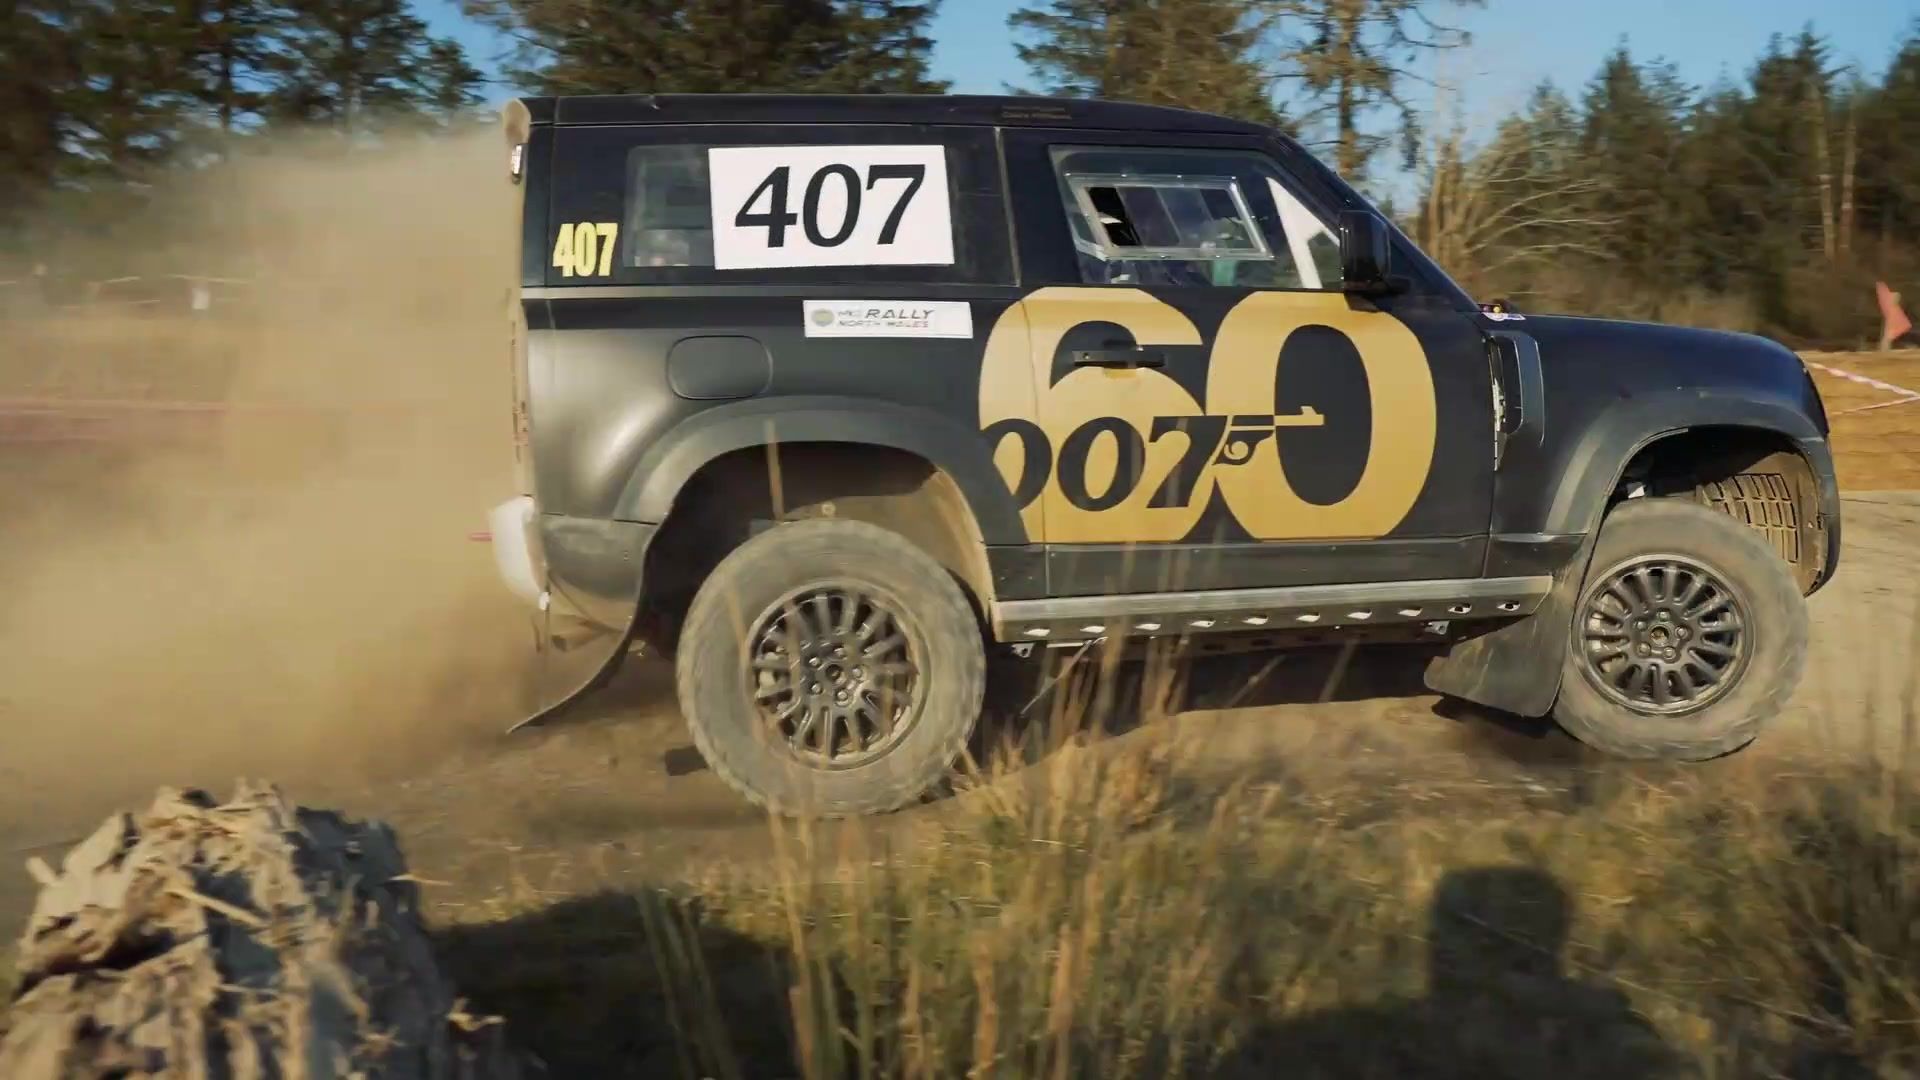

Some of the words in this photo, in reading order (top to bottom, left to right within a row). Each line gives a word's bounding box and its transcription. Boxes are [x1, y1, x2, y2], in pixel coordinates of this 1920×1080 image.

[734, 163, 926, 248] 407
[552, 221, 618, 277] 407
[864, 308, 935, 320] RALLY
[978, 286, 1437, 543] 60
[977, 416, 1229, 512] 007
